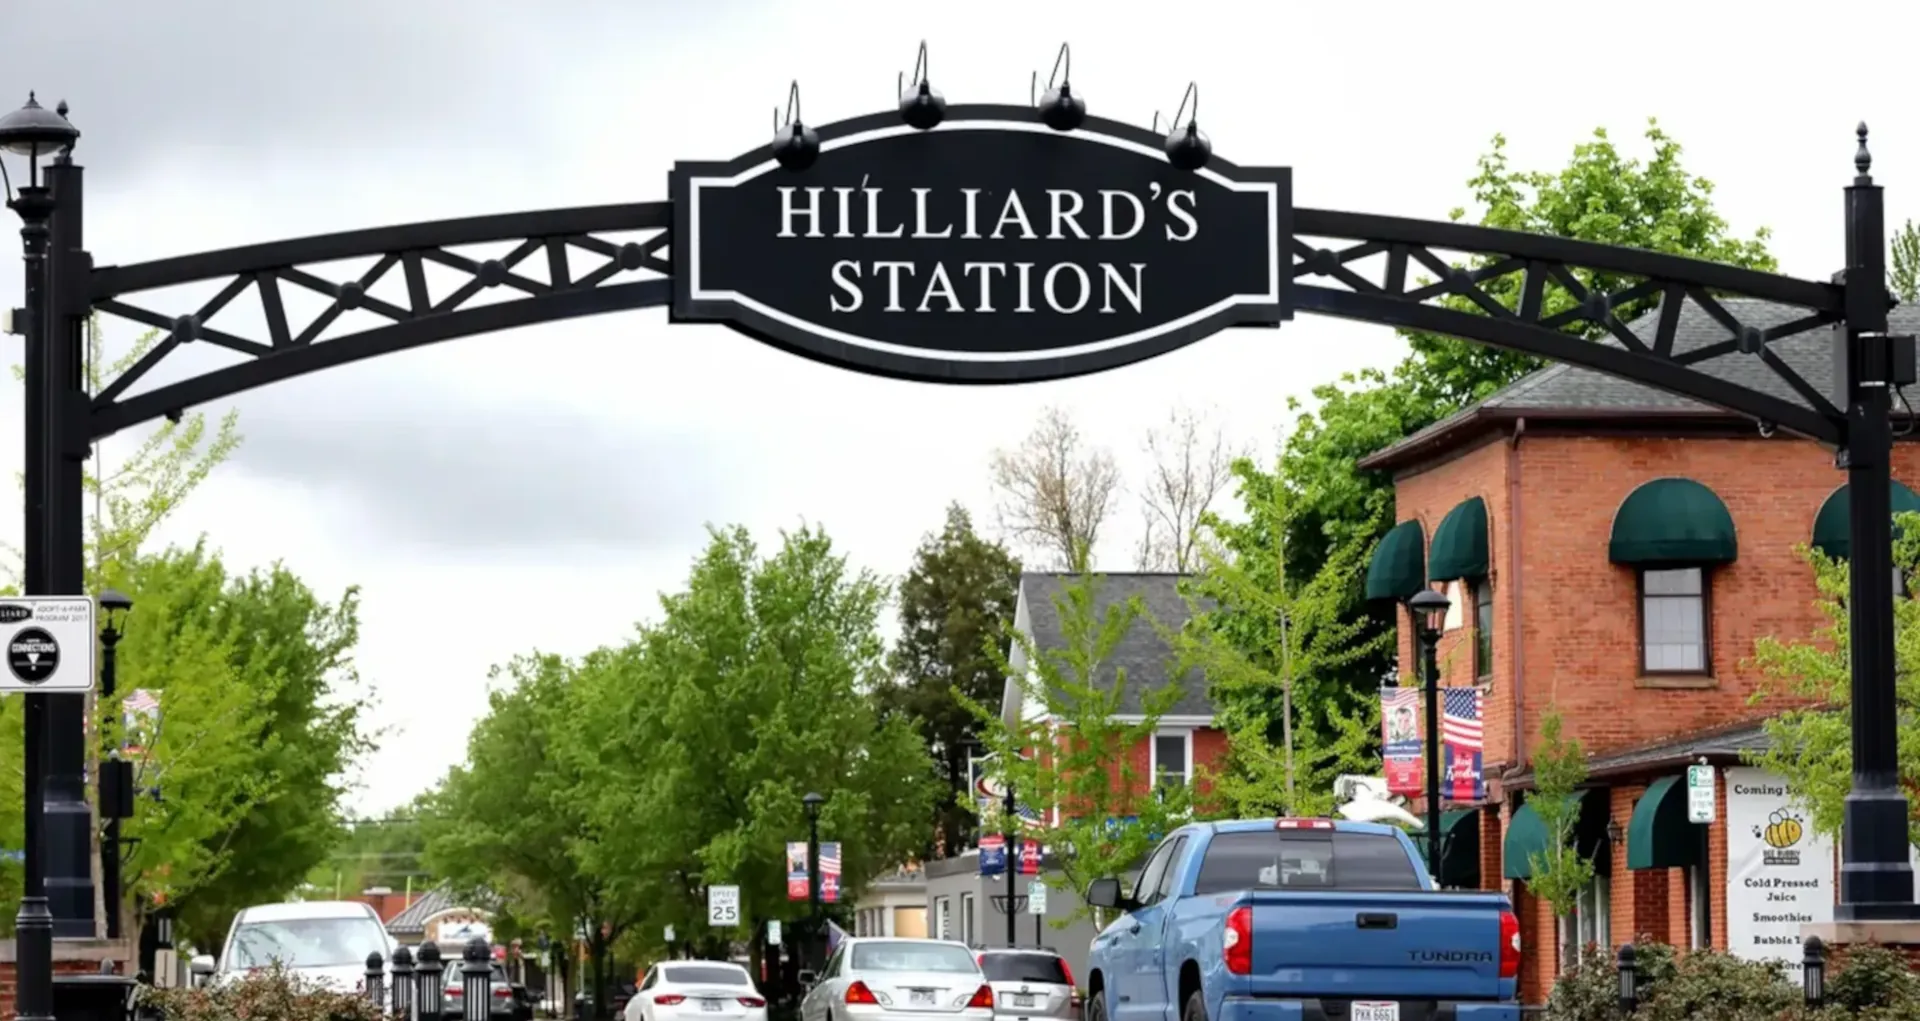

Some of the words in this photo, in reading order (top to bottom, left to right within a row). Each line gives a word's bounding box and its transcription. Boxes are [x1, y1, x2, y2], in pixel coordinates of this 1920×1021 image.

[776, 180, 1199, 242] HILLIARD'S
[829, 259, 1147, 314] STATION
[0, 609, 28, 618] LIARD
[1734, 784, 1783, 797] Coming
[1744, 878, 1771, 888] Cold
[1773, 878, 1819, 888] Pressed
[712, 890, 736, 898] SPEED
[1766, 892, 1797, 902] Juice
[713, 906, 736, 920] 25
[1752, 912, 1813, 922] Smoothies
[1753, 936, 1793, 945] Bubble
[1407, 949, 1493, 962] TUNDRA
